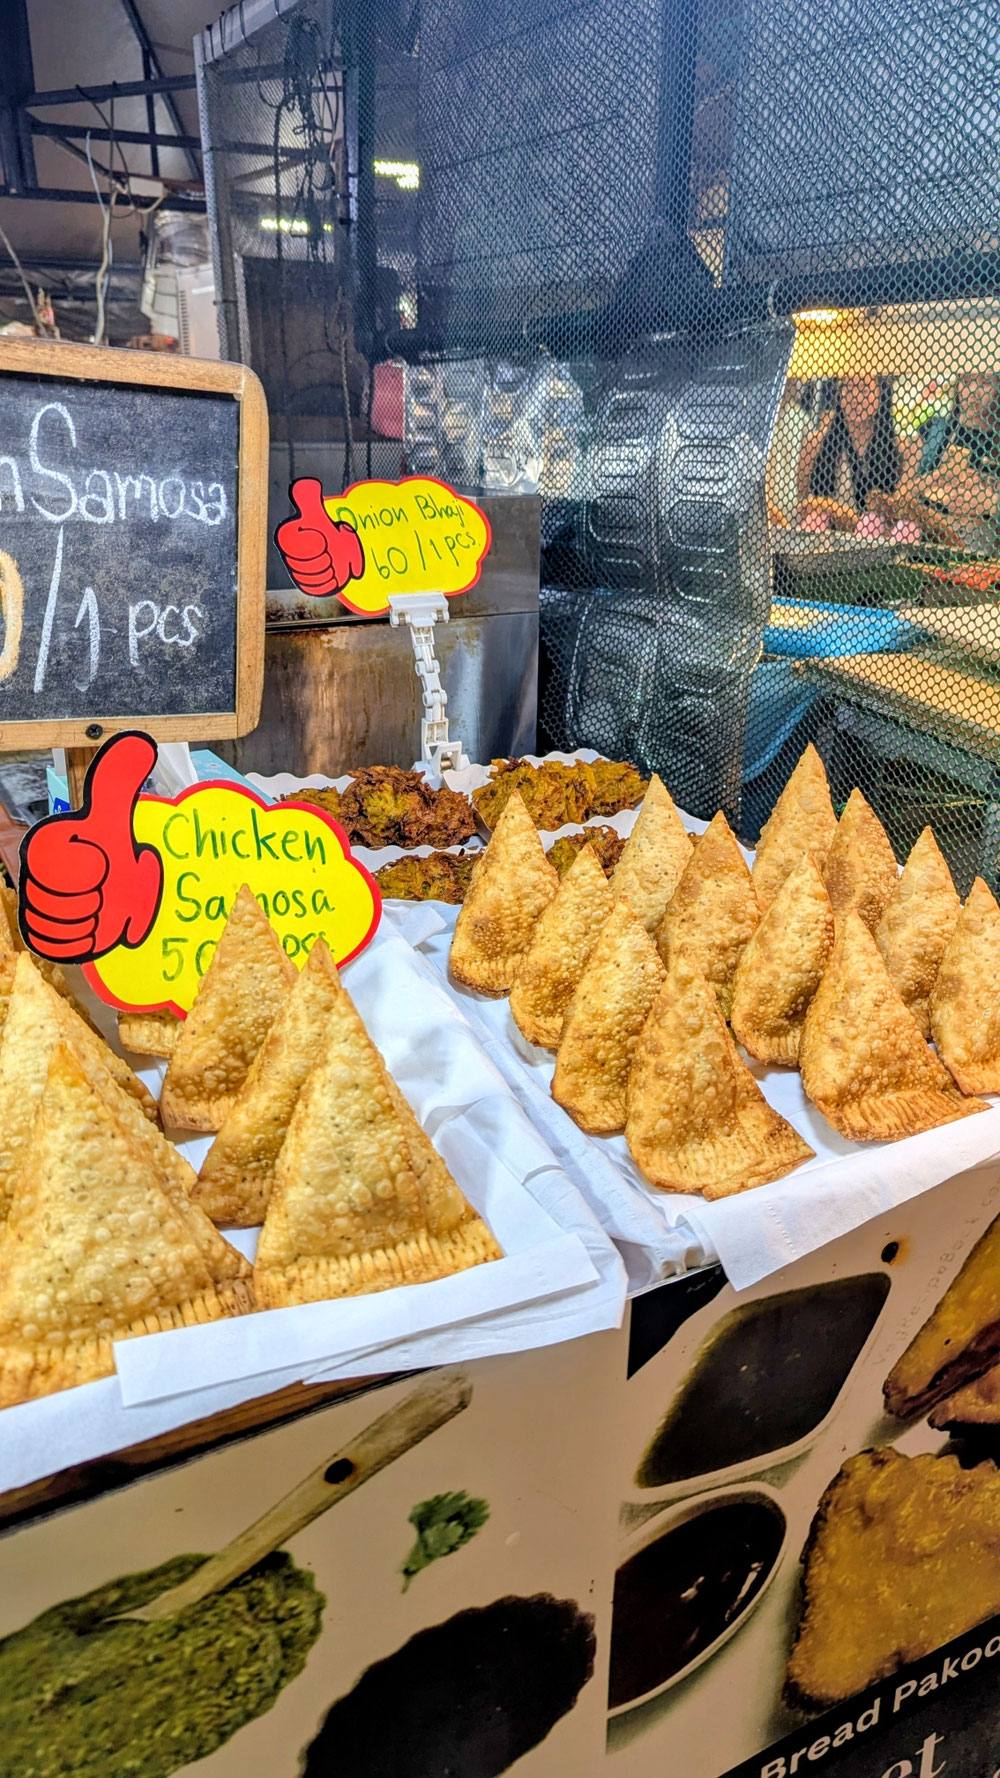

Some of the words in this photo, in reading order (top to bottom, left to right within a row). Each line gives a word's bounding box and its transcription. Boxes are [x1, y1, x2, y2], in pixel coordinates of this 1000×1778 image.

[29, 402, 228, 526] Samosa
[336, 505, 408, 533] Onion
[414, 493, 465, 528] Bhaji
[129, 600, 203, 667] pcs
[162, 808, 326, 865] Chicken
[760, 1698, 881, 1778] Bread
